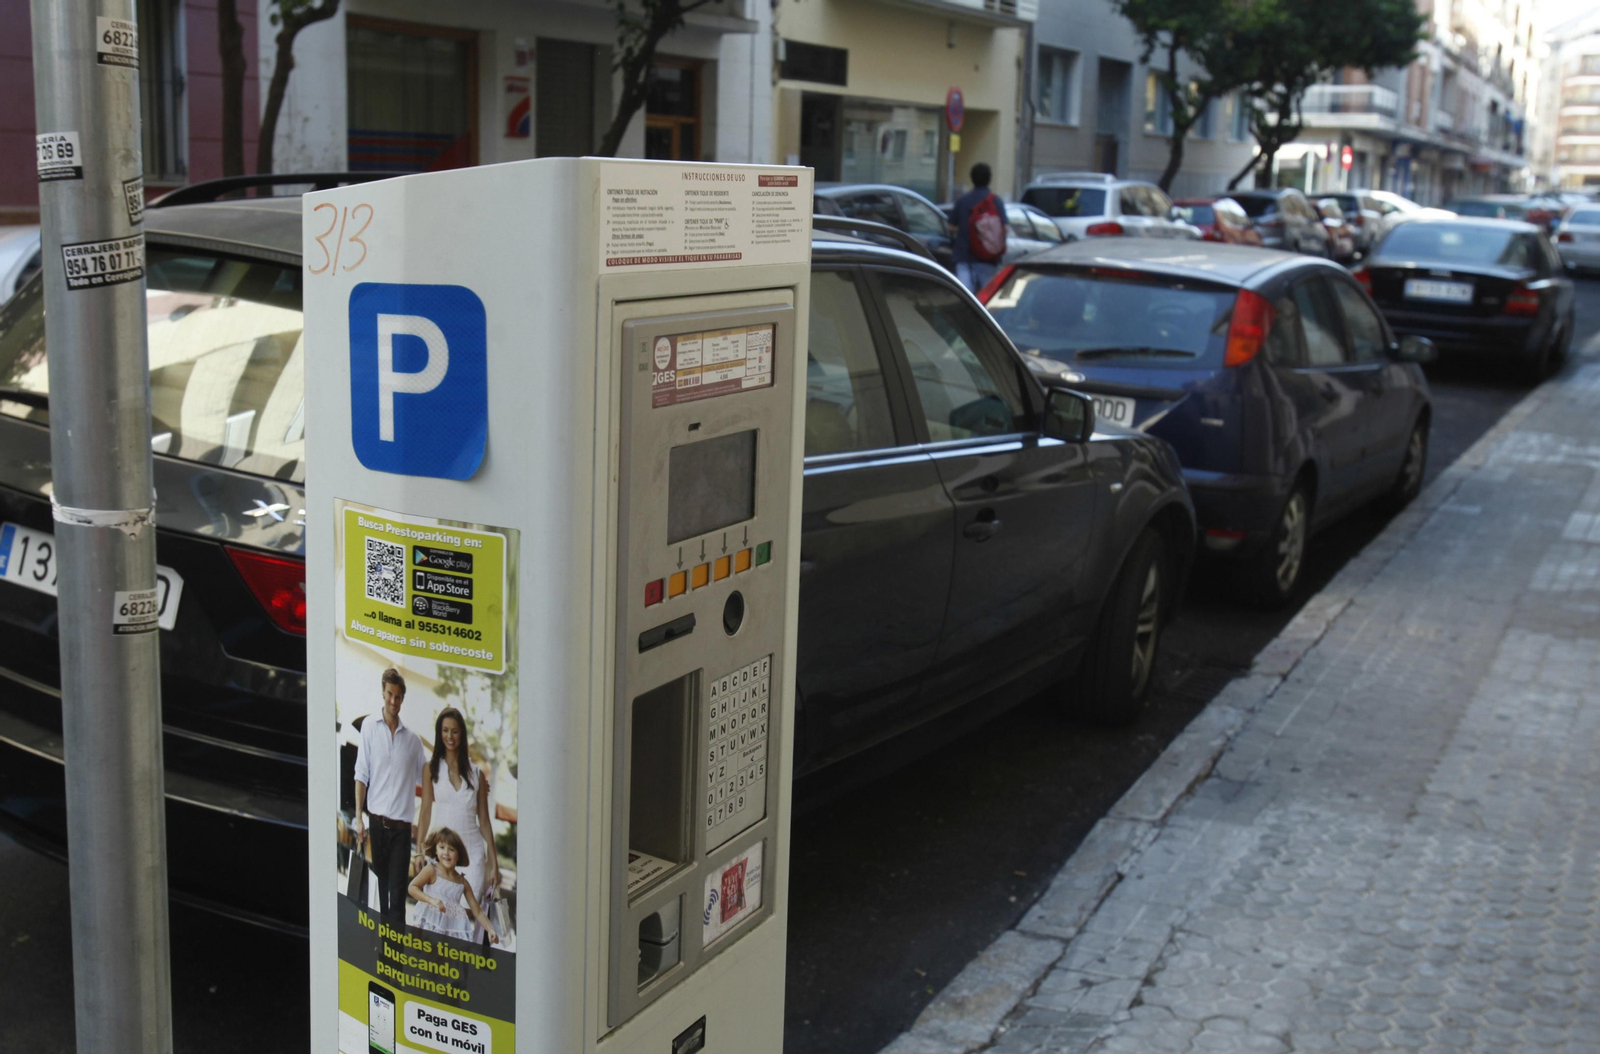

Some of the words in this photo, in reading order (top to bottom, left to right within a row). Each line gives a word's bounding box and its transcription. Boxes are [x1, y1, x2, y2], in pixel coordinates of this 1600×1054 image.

[57, 142, 74, 158] 69
[681, 172, 726, 181] INSTRUCCIONES
[727, 173, 734, 182] DE
[735, 174, 746, 182] USO
[65, 243, 121, 257] CERRAJERO
[67, 258, 88, 276] 954
[91, 255, 106, 272] 76
[109, 253, 122, 270] 07
[125, 251, 136, 267] 71
[607, 258, 633, 266] COLOQUE
[68, 278, 89, 287] Todo
[377, 313, 449, 442] P
[657, 370, 676, 383] GES
[358, 516, 384, 532] Busca
[386, 523, 461, 547] Prestoparking
[464, 538, 483, 548] en:
[18, 535, 57, 585] 13
[429, 555, 455, 568] Google
[456, 560, 471, 570] play
[427, 573, 455, 583] Disponible
[427, 581, 446, 594] App
[447, 584, 470, 596] Store
[432, 602, 460, 614] BlackBerry
[432, 610, 447, 618] World
[379, 611, 402, 627] llama
[405, 620, 415, 629] al
[418, 621, 482, 641] 955314602
[351, 620, 375, 635] Ahora
[377, 628, 406, 645] aparca
[410, 637, 426, 648] sin
[430, 642, 494, 661] sobrecoste
[711, 686, 717, 697] A
[722, 681, 727, 692] B
[732, 676, 738, 686] C
[743, 671, 748, 682] D
[753, 667, 757, 677] E
[763, 662, 767, 672] F
[711, 709, 716, 719] G
[721, 703, 726, 713] H
[742, 692, 746, 702] J
[752, 687, 757, 697] K
[762, 683, 766, 693] L
[710, 731, 716, 741] M
[721, 724, 726, 735] N
[742, 714, 746, 724] P
[751, 708, 756, 719] Q
[761, 703, 766, 713] R
[710, 751, 714, 761] S
[720, 745, 725, 755] T
[731, 740, 735, 750] U
[741, 735, 746, 745] V
[750, 729, 757, 739] W
[760, 723, 765, 734] X
[709, 772, 714, 783] Y
[719, 766, 724, 777] Z
[730, 782, 734, 792] 2
[740, 776, 744, 786] 3
[750, 770, 754, 780] 4
[759, 764, 764, 774] 5
[707, 815, 712, 825] 6
[718, 810, 722, 819] 7
[728, 803, 733, 813] 8
[739, 797, 743, 807] 9
[358, 910, 375, 930] No
[378, 924, 432, 953] pierdas
[437, 942, 497, 970] tiempo
[383, 942, 460, 979] buscando
[377, 960, 470, 1002] parquímetro
[417, 1008, 448, 1027] Paga
[451, 1019, 478, 1036] GES
[410, 1025, 433, 1039] con
[435, 1031, 448, 1044] tu
[451, 1036, 485, 1054] móvil
